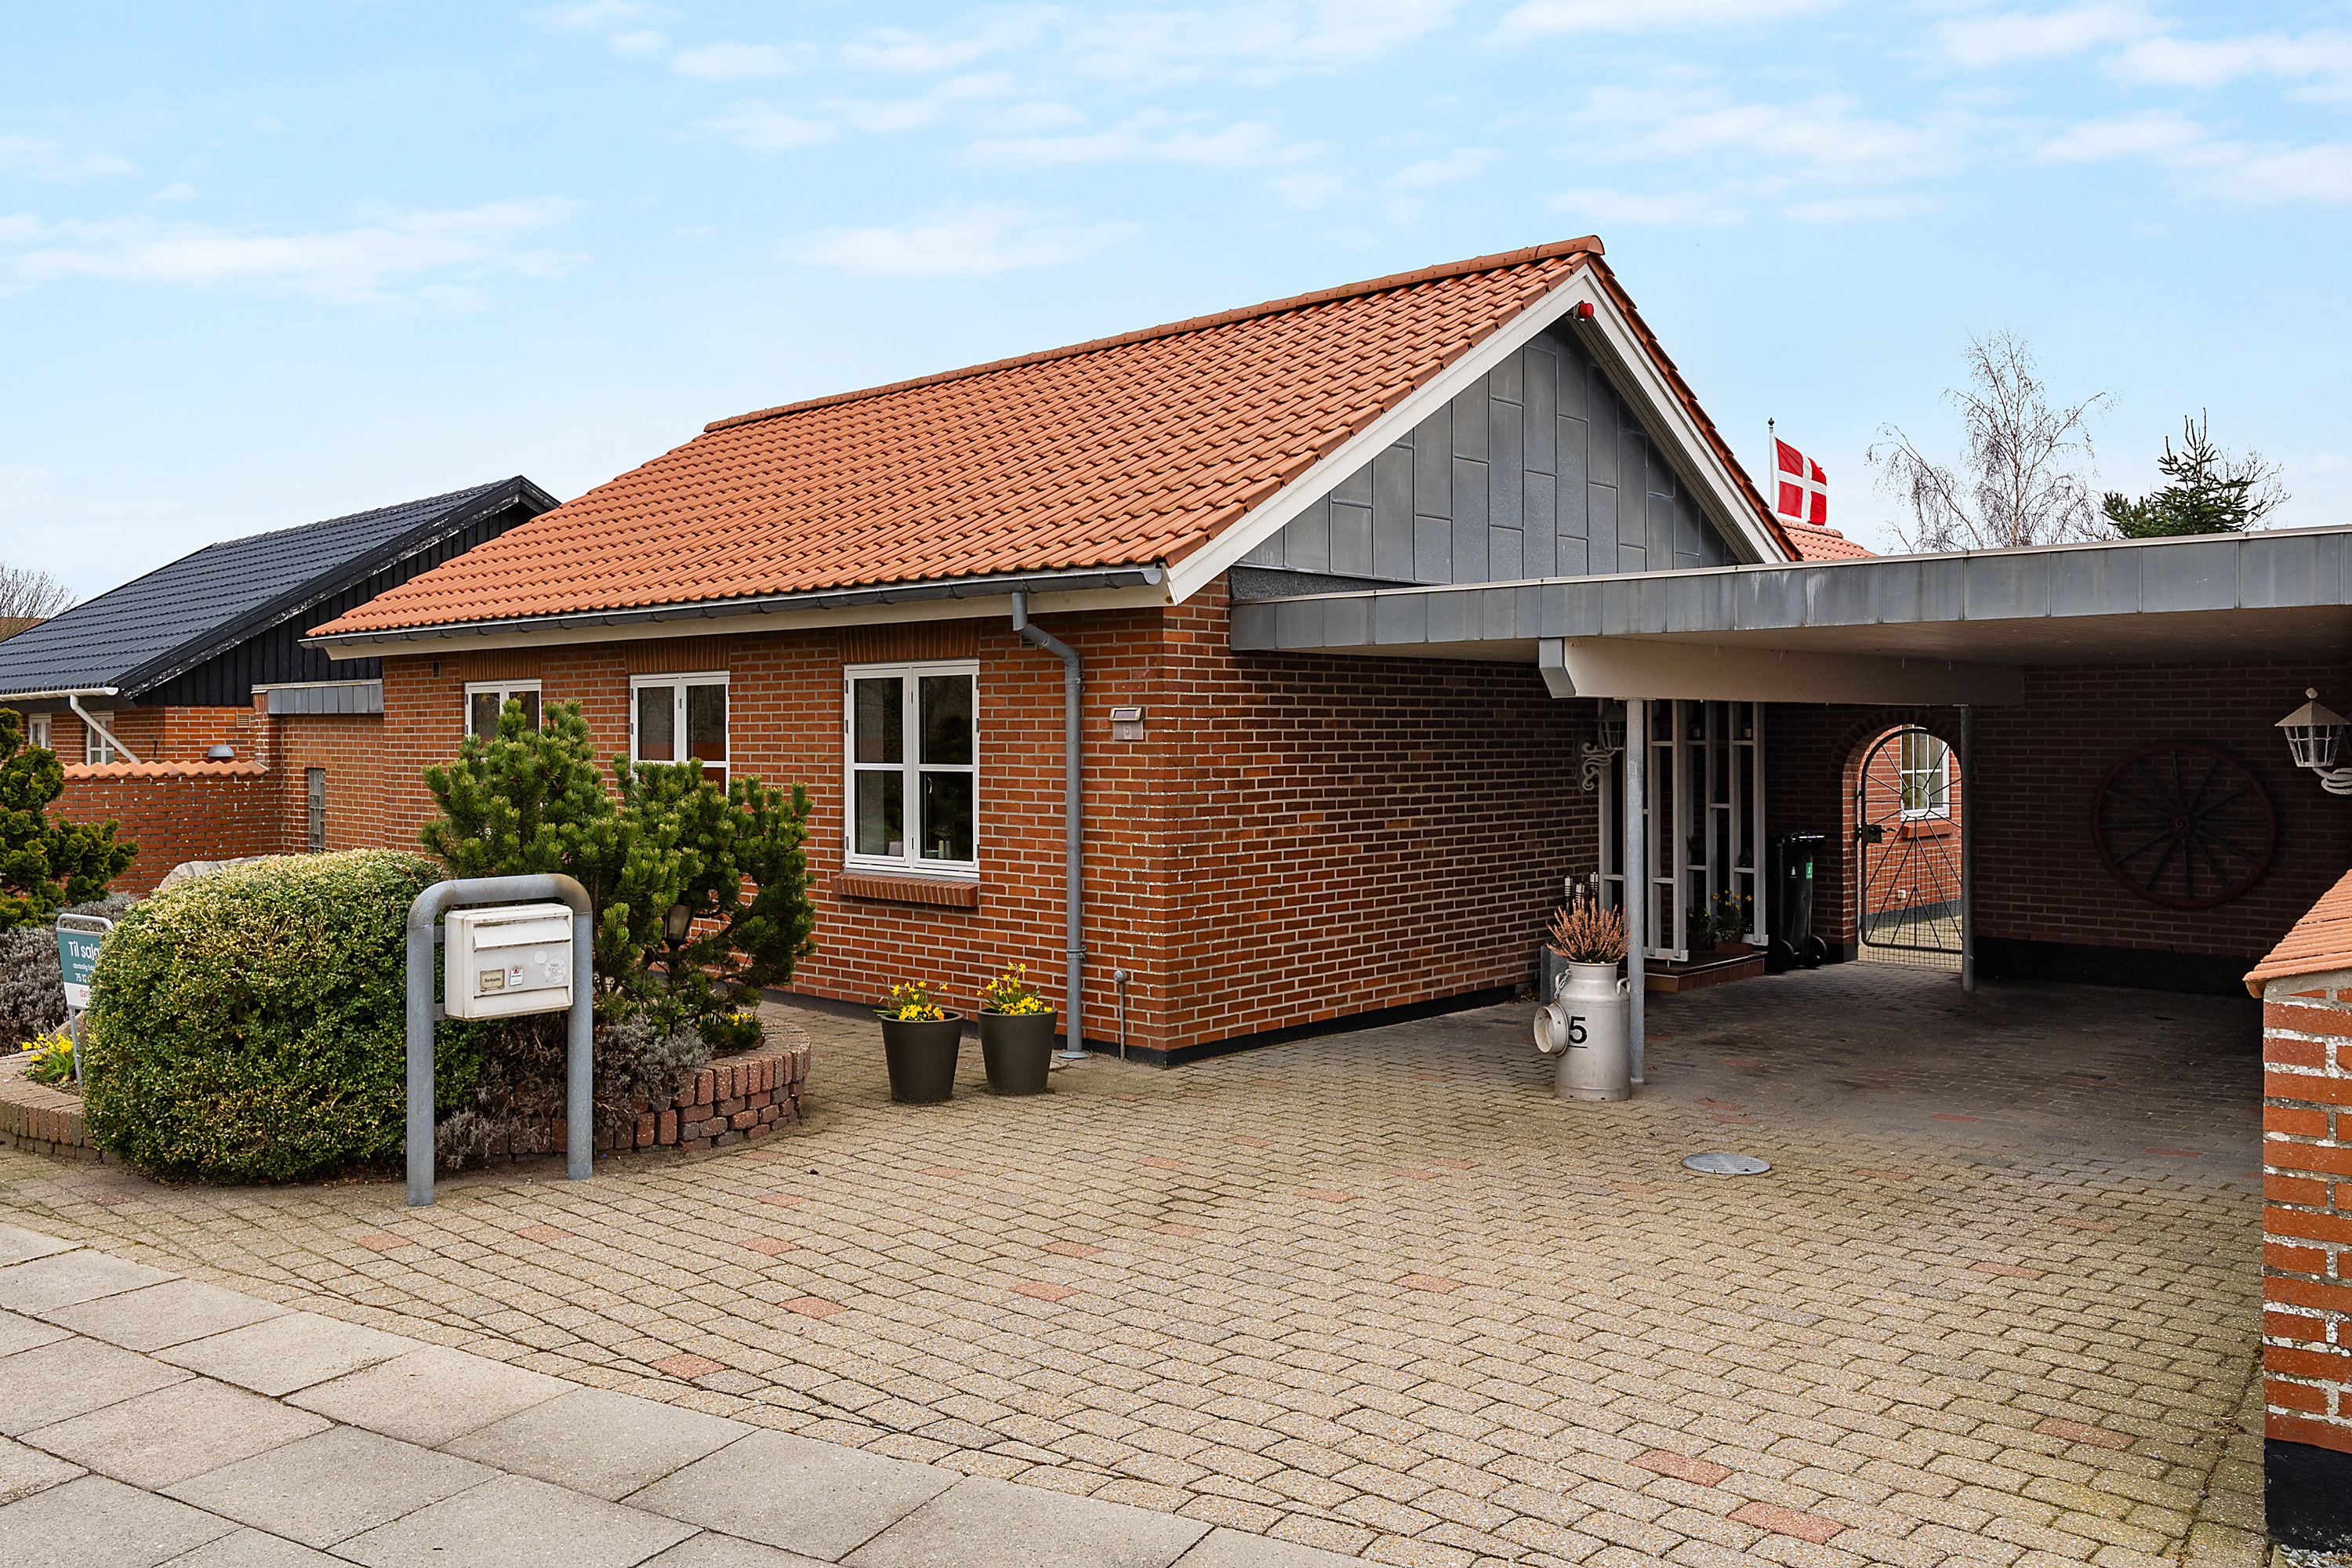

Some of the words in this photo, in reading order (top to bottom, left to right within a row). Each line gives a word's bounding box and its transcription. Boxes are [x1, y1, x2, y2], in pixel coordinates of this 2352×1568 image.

[1124, 724, 1131, 735] 5
[68, 941, 79, 957] Til
[80, 943, 100, 964] salg
[73, 963, 88, 972] danbolig
[74, 972, 82, 982] 75
[79, 988, 89, 998] dan
[1568, 1015, 1588, 1044] 5
